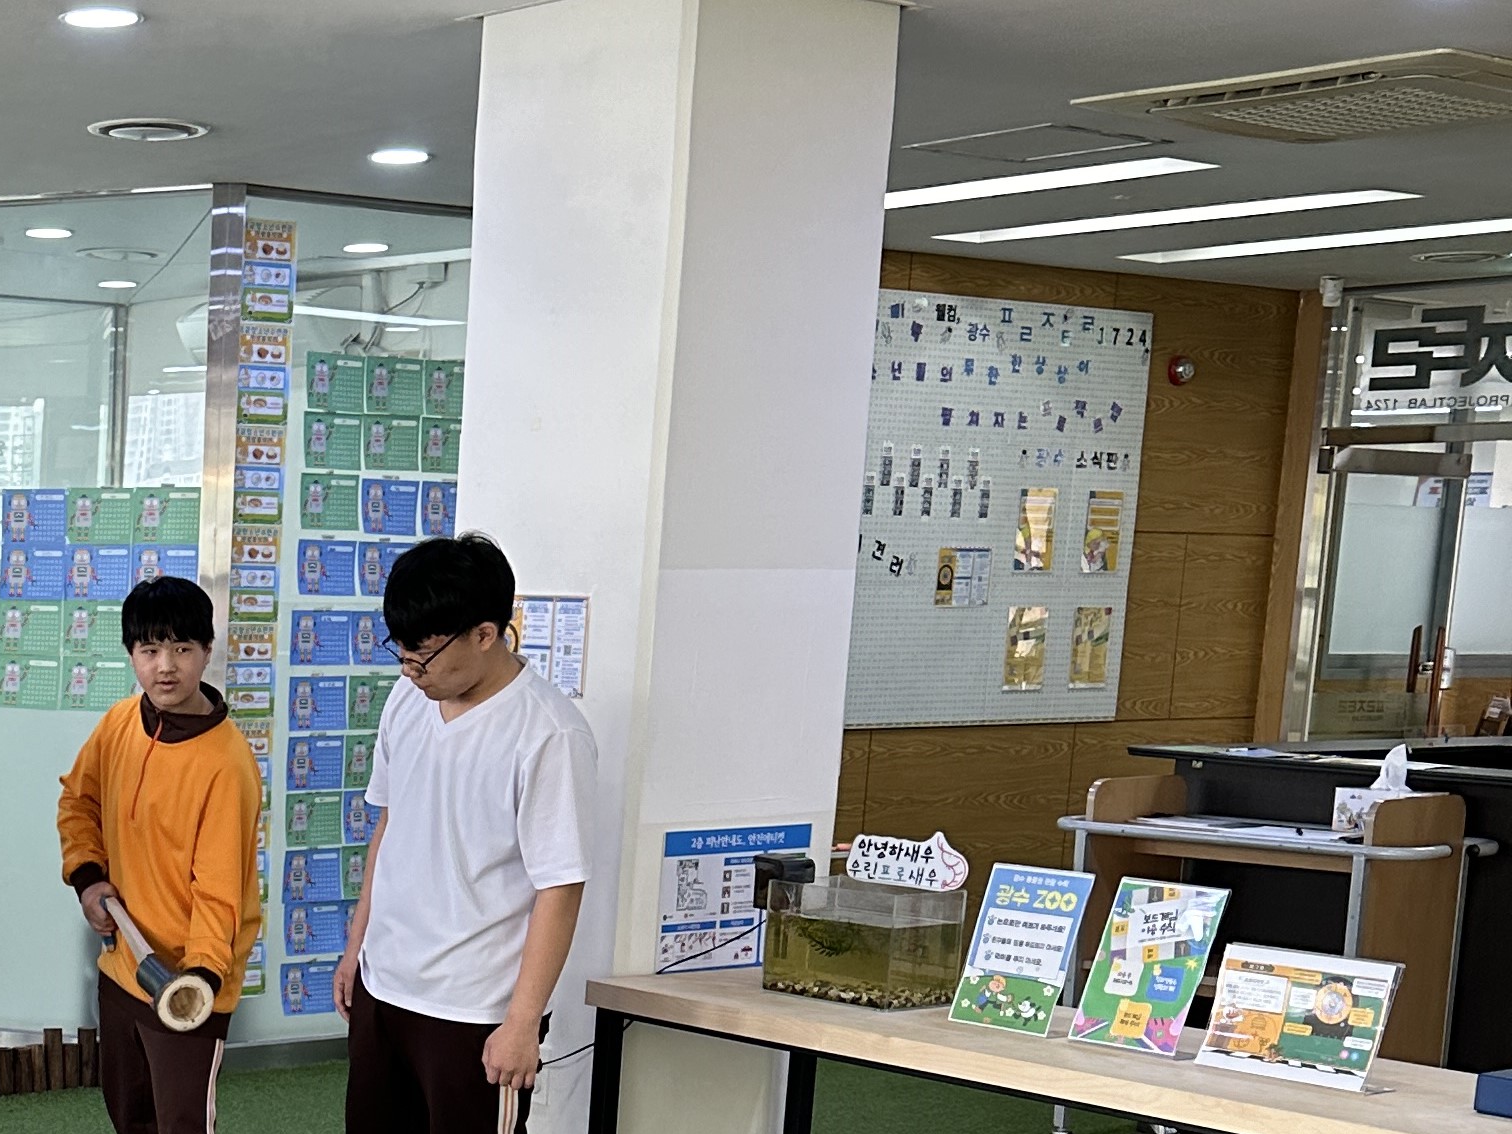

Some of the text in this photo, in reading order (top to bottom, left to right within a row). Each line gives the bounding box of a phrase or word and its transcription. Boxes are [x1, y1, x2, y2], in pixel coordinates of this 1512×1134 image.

[967, 322, 991, 342] 광수
[1096, 325, 1148, 347] 1724
[1075, 450, 1118, 472] 소식판
[858, 838, 935, 864] 안녕하새우
[848, 859, 878, 880] 우린
[996, 884, 1078, 912] 광수 ZOO
